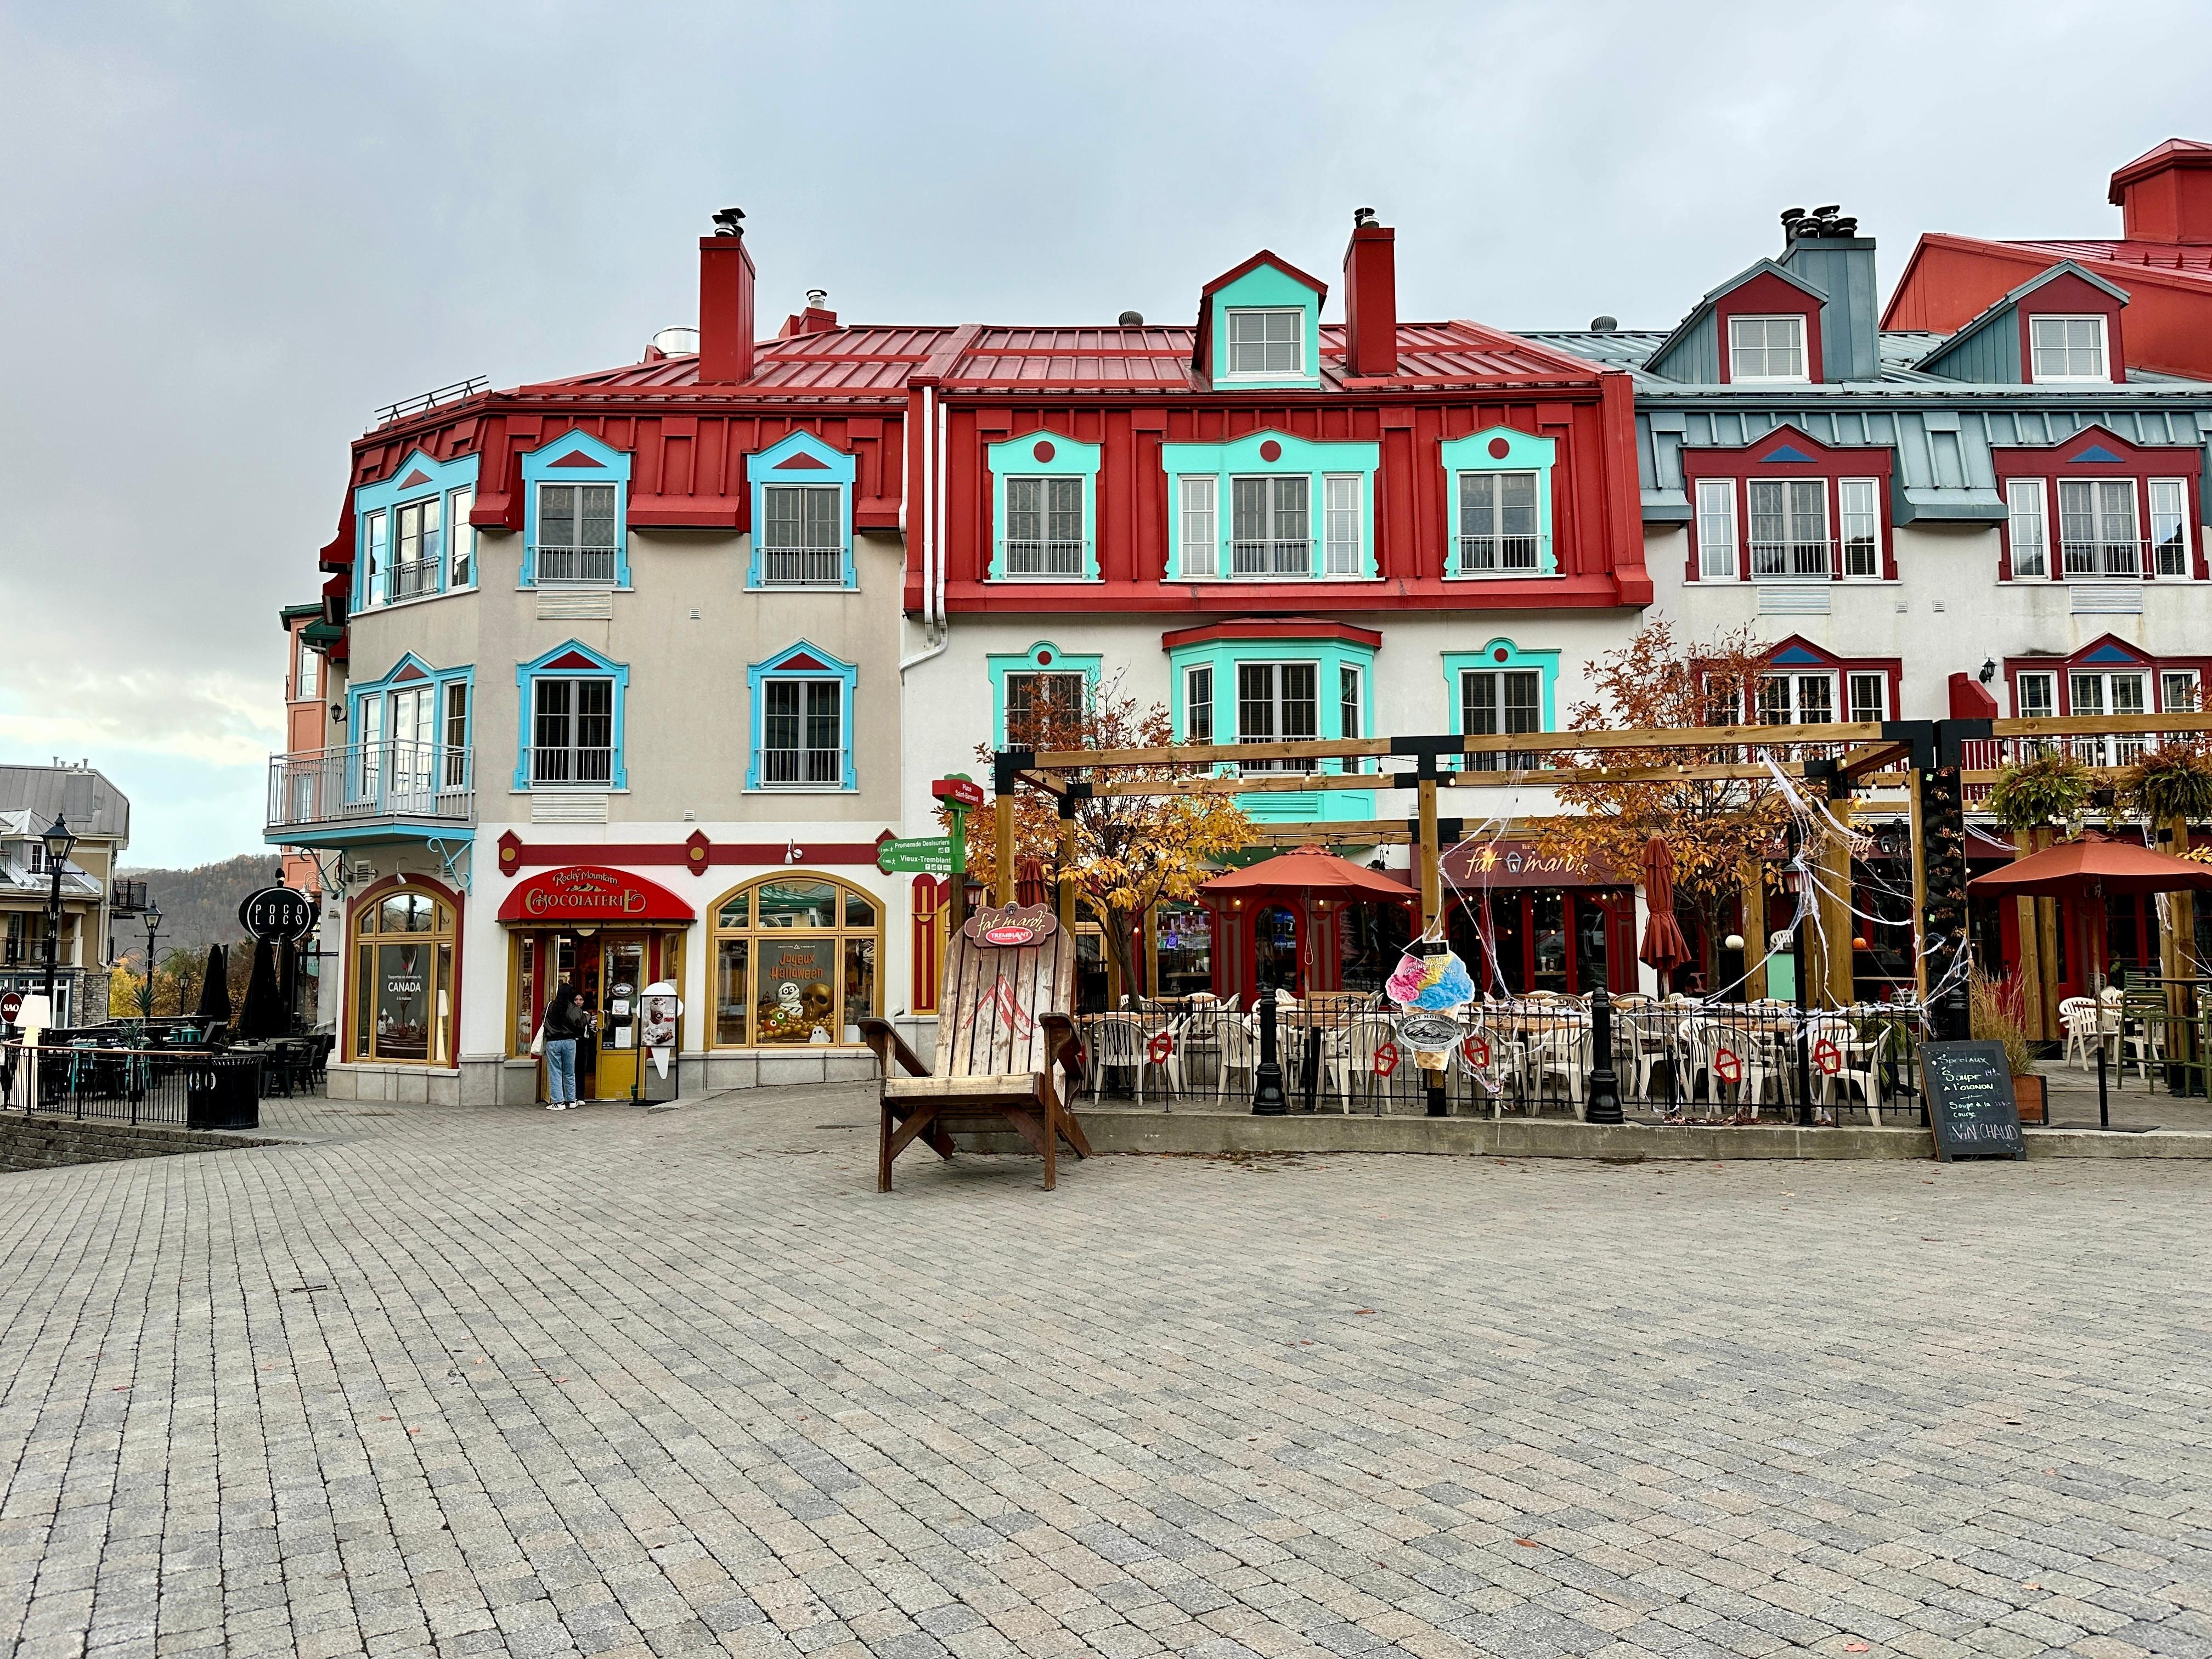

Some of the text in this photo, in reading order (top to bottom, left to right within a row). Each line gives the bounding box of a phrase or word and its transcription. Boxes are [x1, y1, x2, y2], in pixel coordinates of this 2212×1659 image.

[962, 783, 972, 792] Place
[900, 855, 951, 864] Vieux-Tremblant
[1465, 847, 1503, 879] fat
[552, 868, 620, 887] Rocky Mountain
[525, 888, 646, 915] CHOCOLATERIE
[256, 904, 303, 915] POCO
[255, 915, 302, 925] LOCO
[977, 912, 1001, 938] fat
[990, 931, 1030, 941] TREMBLANT
[779, 950, 815, 967] Joyeux
[770, 966, 823, 980] Halloween
[387, 981, 421, 992] CANADA
[1401, 1014, 1459, 1030] ROCKY MOUNTAIN
[1979, 1123, 2018, 1141] CHAUD
